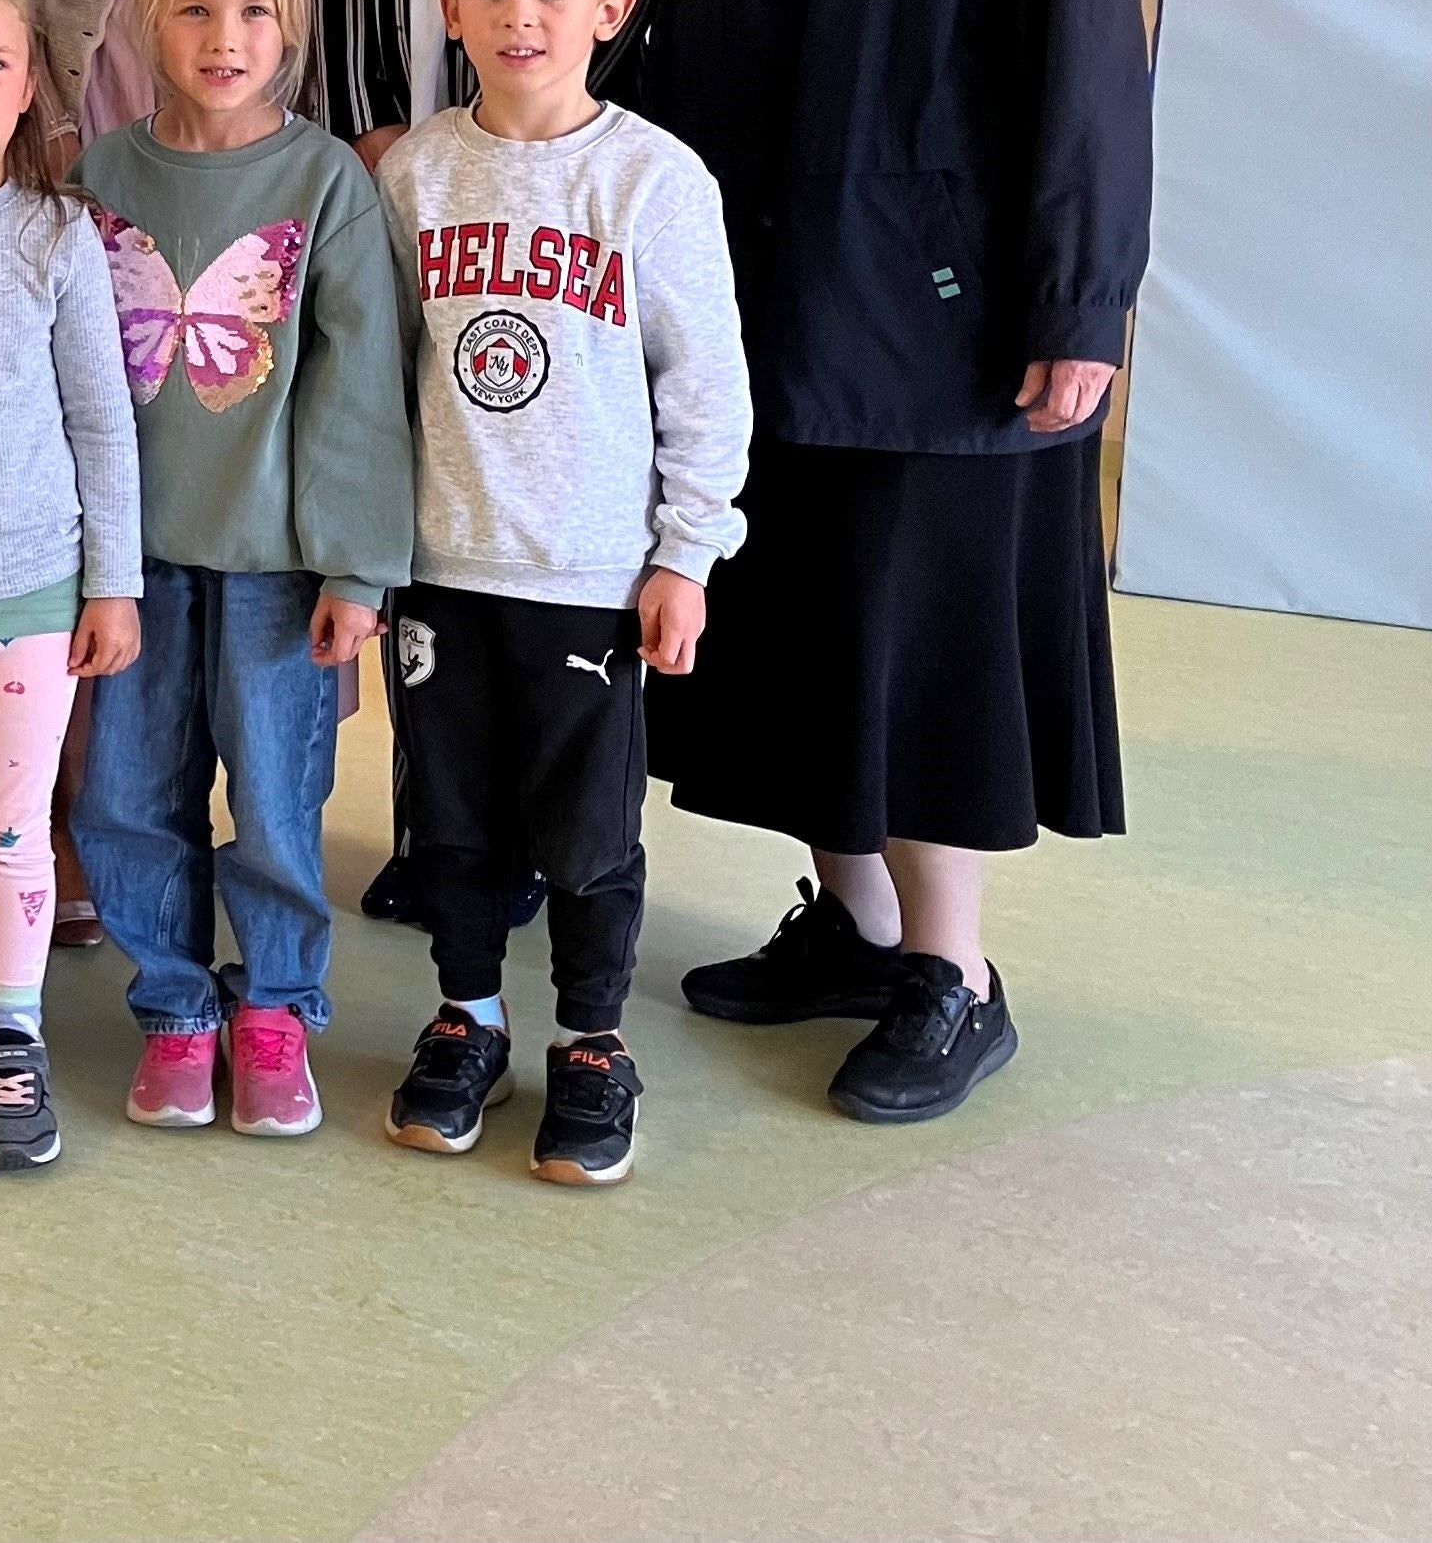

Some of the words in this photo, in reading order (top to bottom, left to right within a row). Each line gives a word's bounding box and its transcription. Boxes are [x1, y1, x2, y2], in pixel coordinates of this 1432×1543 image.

[462, 326, 482, 353] EAST
[484, 319, 521, 333] COAST
[520, 329, 541, 358] DEPT
[471, 383, 495, 402] NEW
[497, 387, 527, 403] YORK
[431, 1022, 467, 1037] FILA
[569, 1050, 611, 1070] FILA
